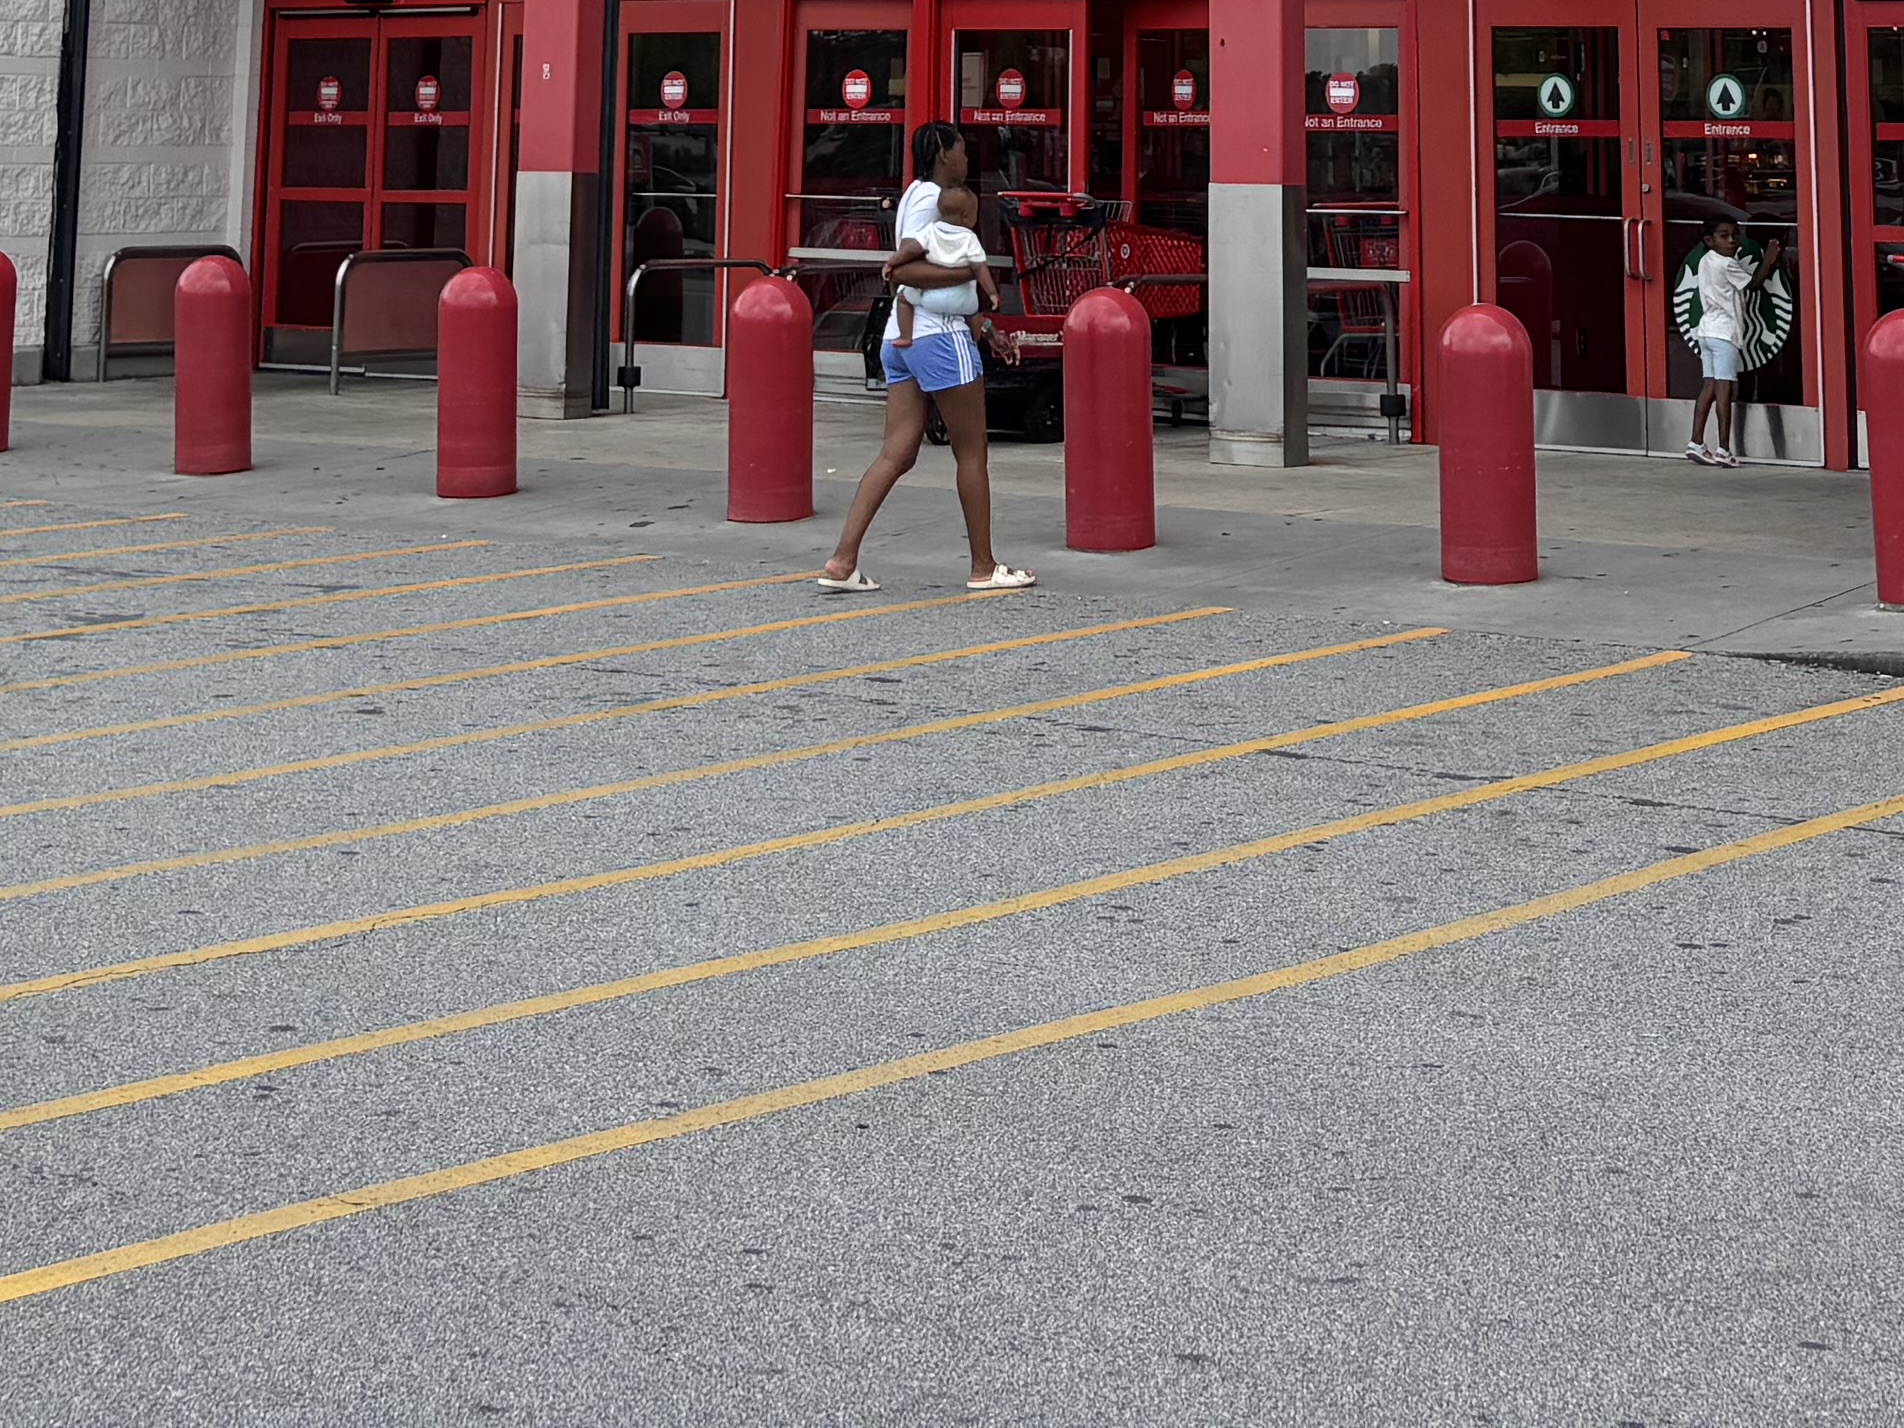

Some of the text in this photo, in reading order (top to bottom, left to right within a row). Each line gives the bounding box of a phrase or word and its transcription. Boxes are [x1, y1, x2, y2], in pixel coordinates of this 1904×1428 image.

[851, 110, 891, 121] Entrance
[1336, 116, 1382, 128] Entrance
[1704, 123, 1751, 135] Entrance
